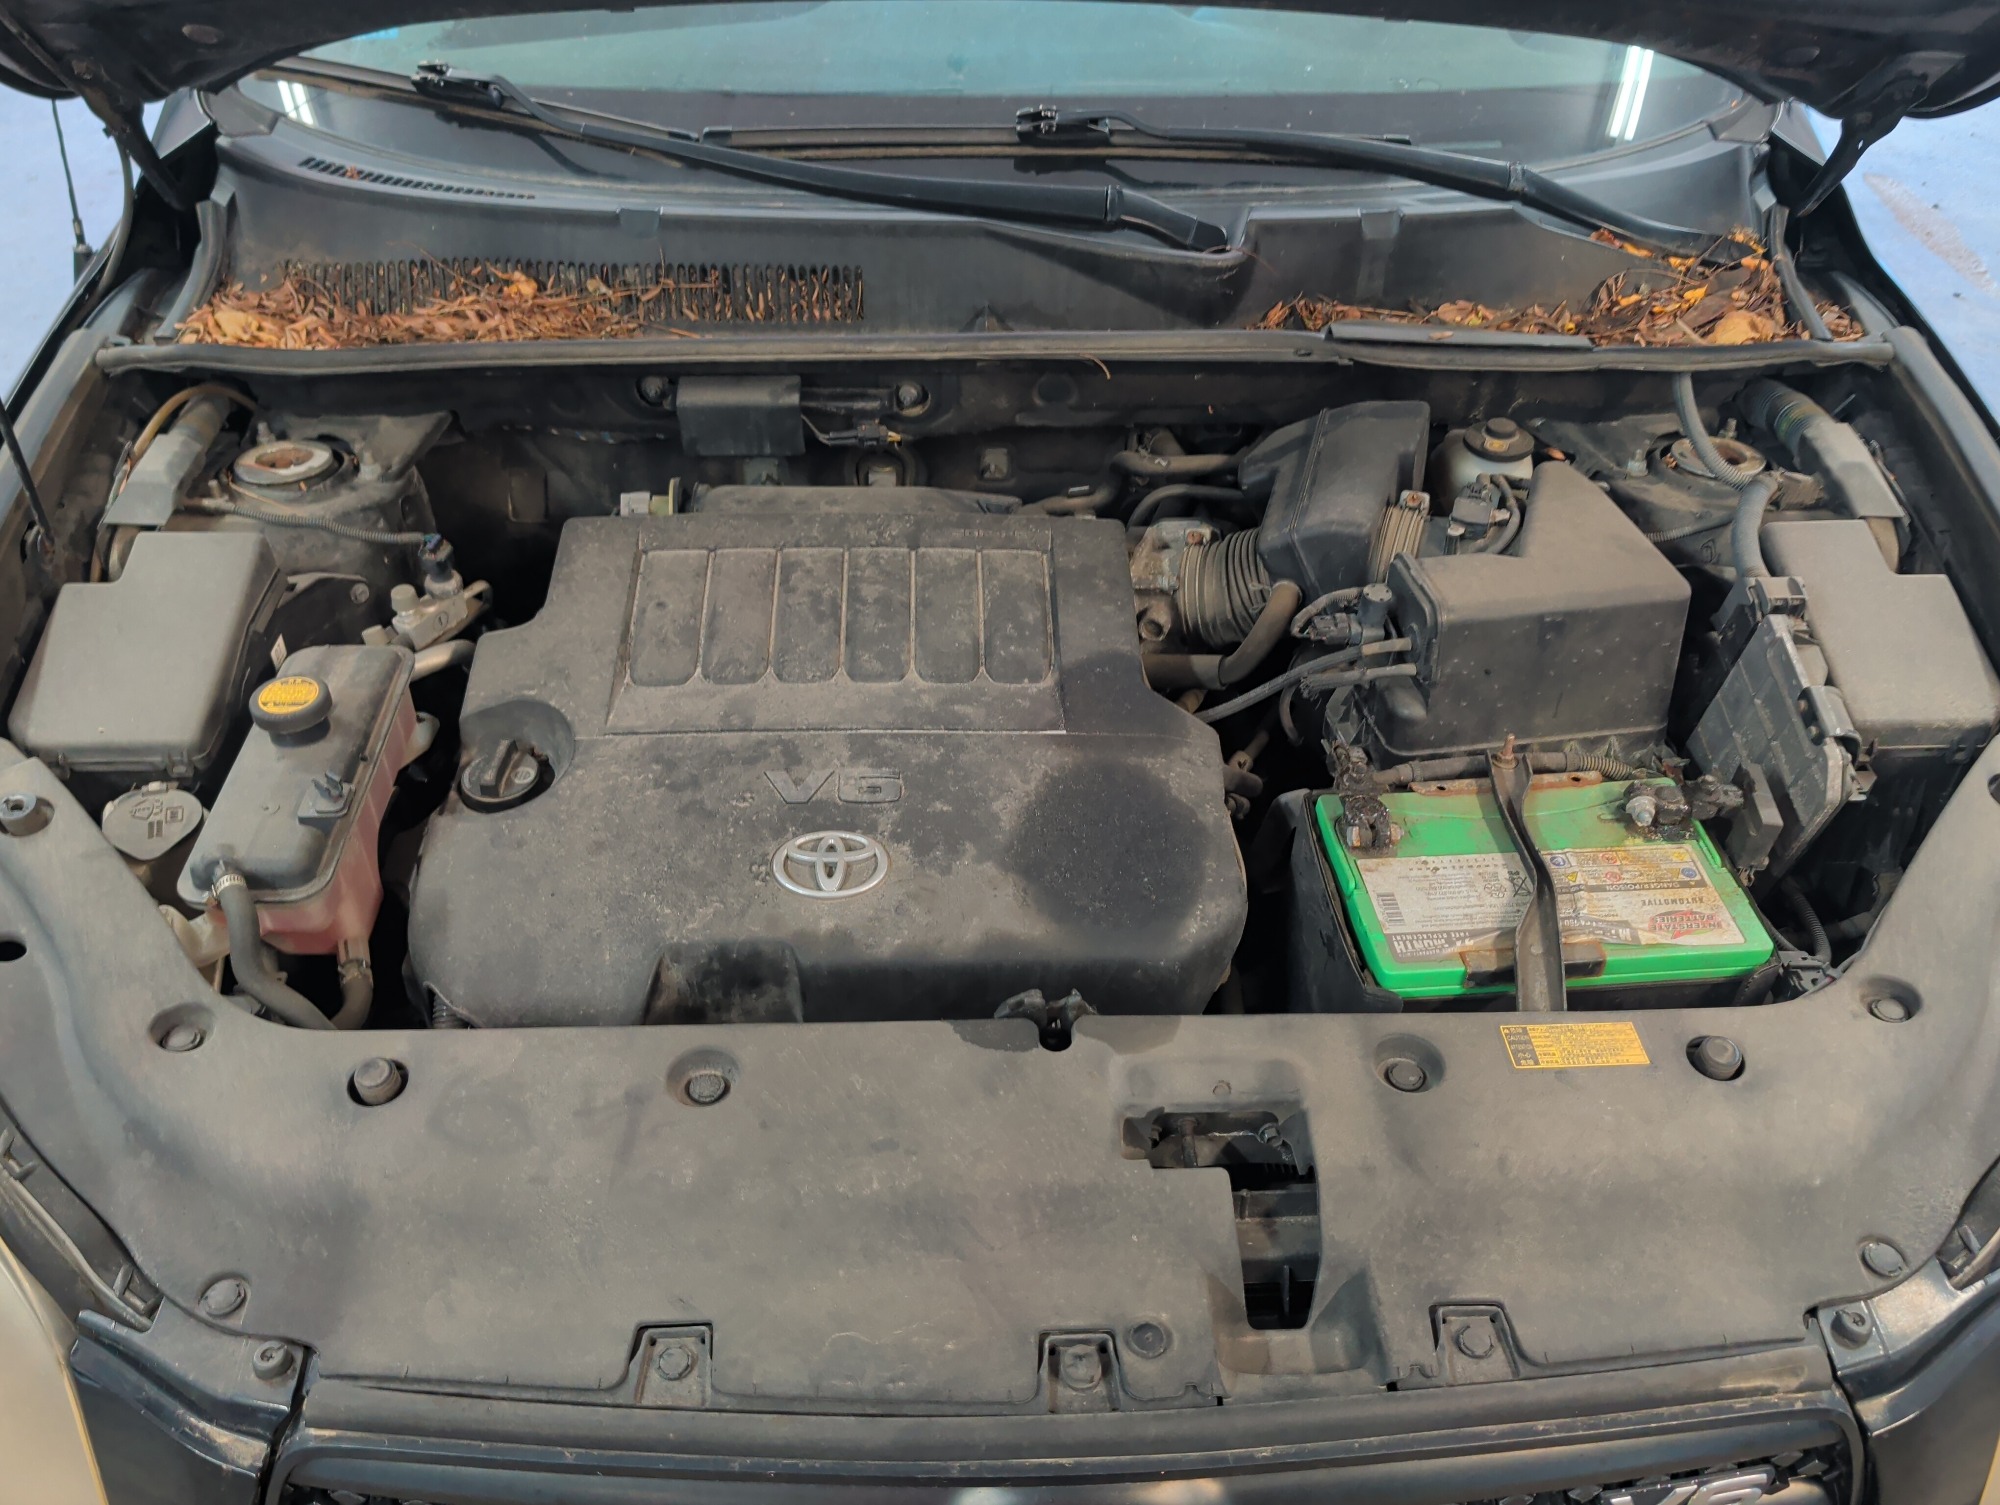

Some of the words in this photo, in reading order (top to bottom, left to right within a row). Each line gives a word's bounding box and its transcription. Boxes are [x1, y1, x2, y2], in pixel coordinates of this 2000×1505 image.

[763, 770, 904, 804] V6
[1606, 882, 1678, 890] DANGER/POISON
[1641, 896, 1704, 906] AUTOMOTIVE
[1652, 914, 1714, 923] BATTERIES
[1650, 921, 1723, 931] INTERSTATE
[1392, 932, 1447, 941] REPLACEMENT
[1394, 938, 1446, 952] MONTH
